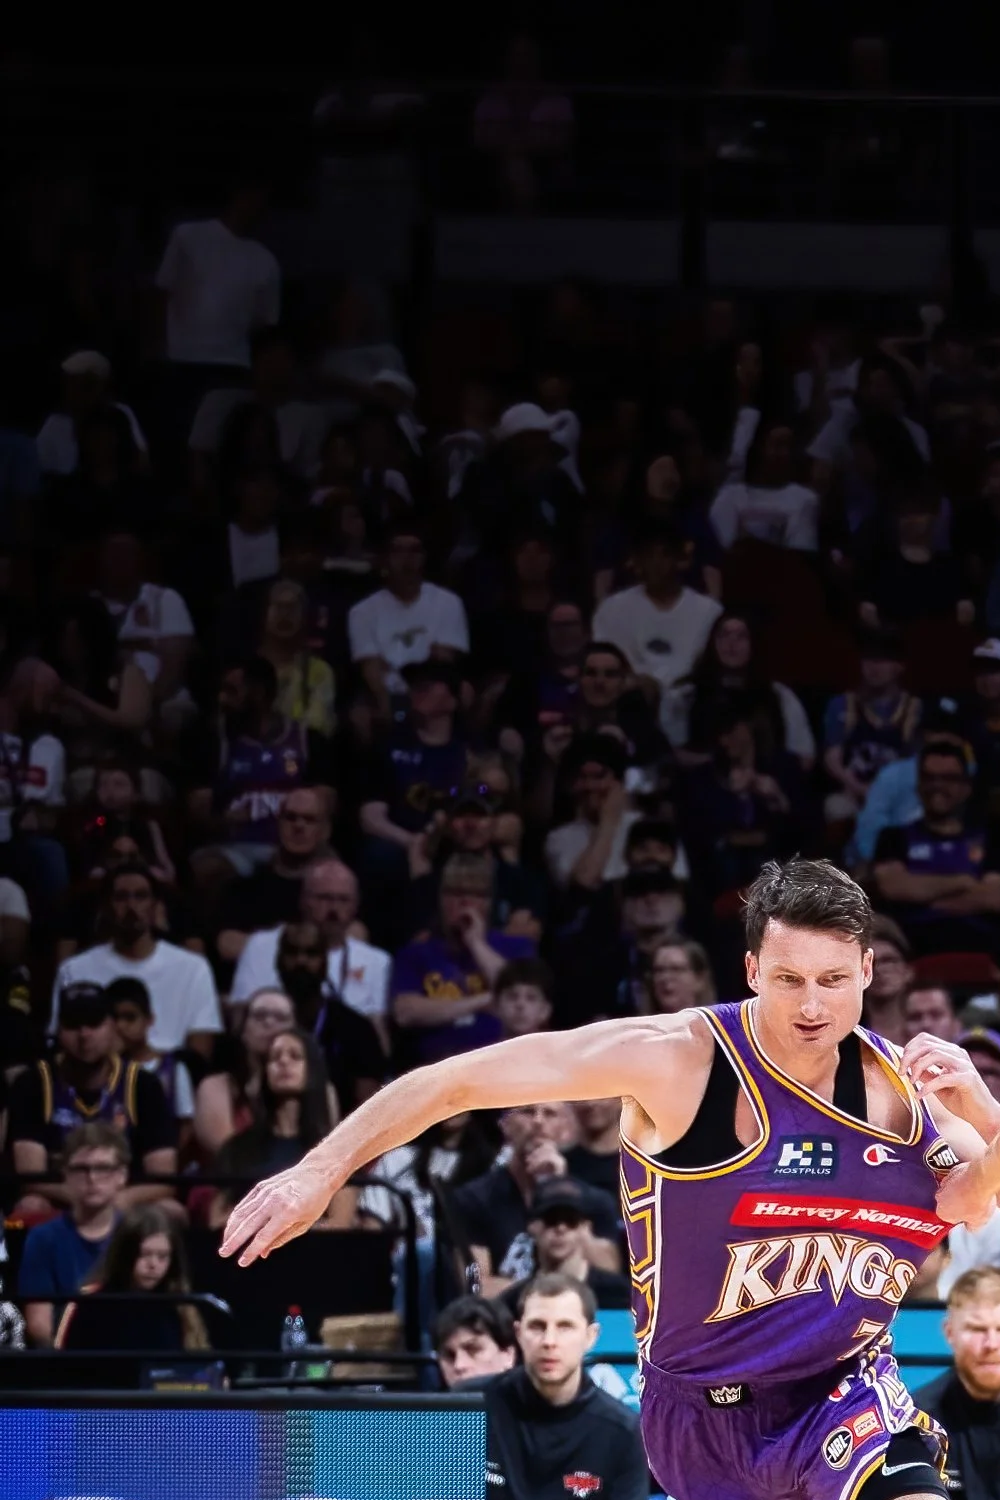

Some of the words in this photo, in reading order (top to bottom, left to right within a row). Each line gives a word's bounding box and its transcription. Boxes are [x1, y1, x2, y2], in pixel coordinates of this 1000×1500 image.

[932, 1146, 960, 1166] NBL
[773, 1167, 832, 1176] HOSTPLUS
[751, 1202, 851, 1222] Harvey
[848, 1208, 944, 1236] Norman
[703, 1233, 918, 1324] KINGS
[827, 1433, 849, 1461] NBL
